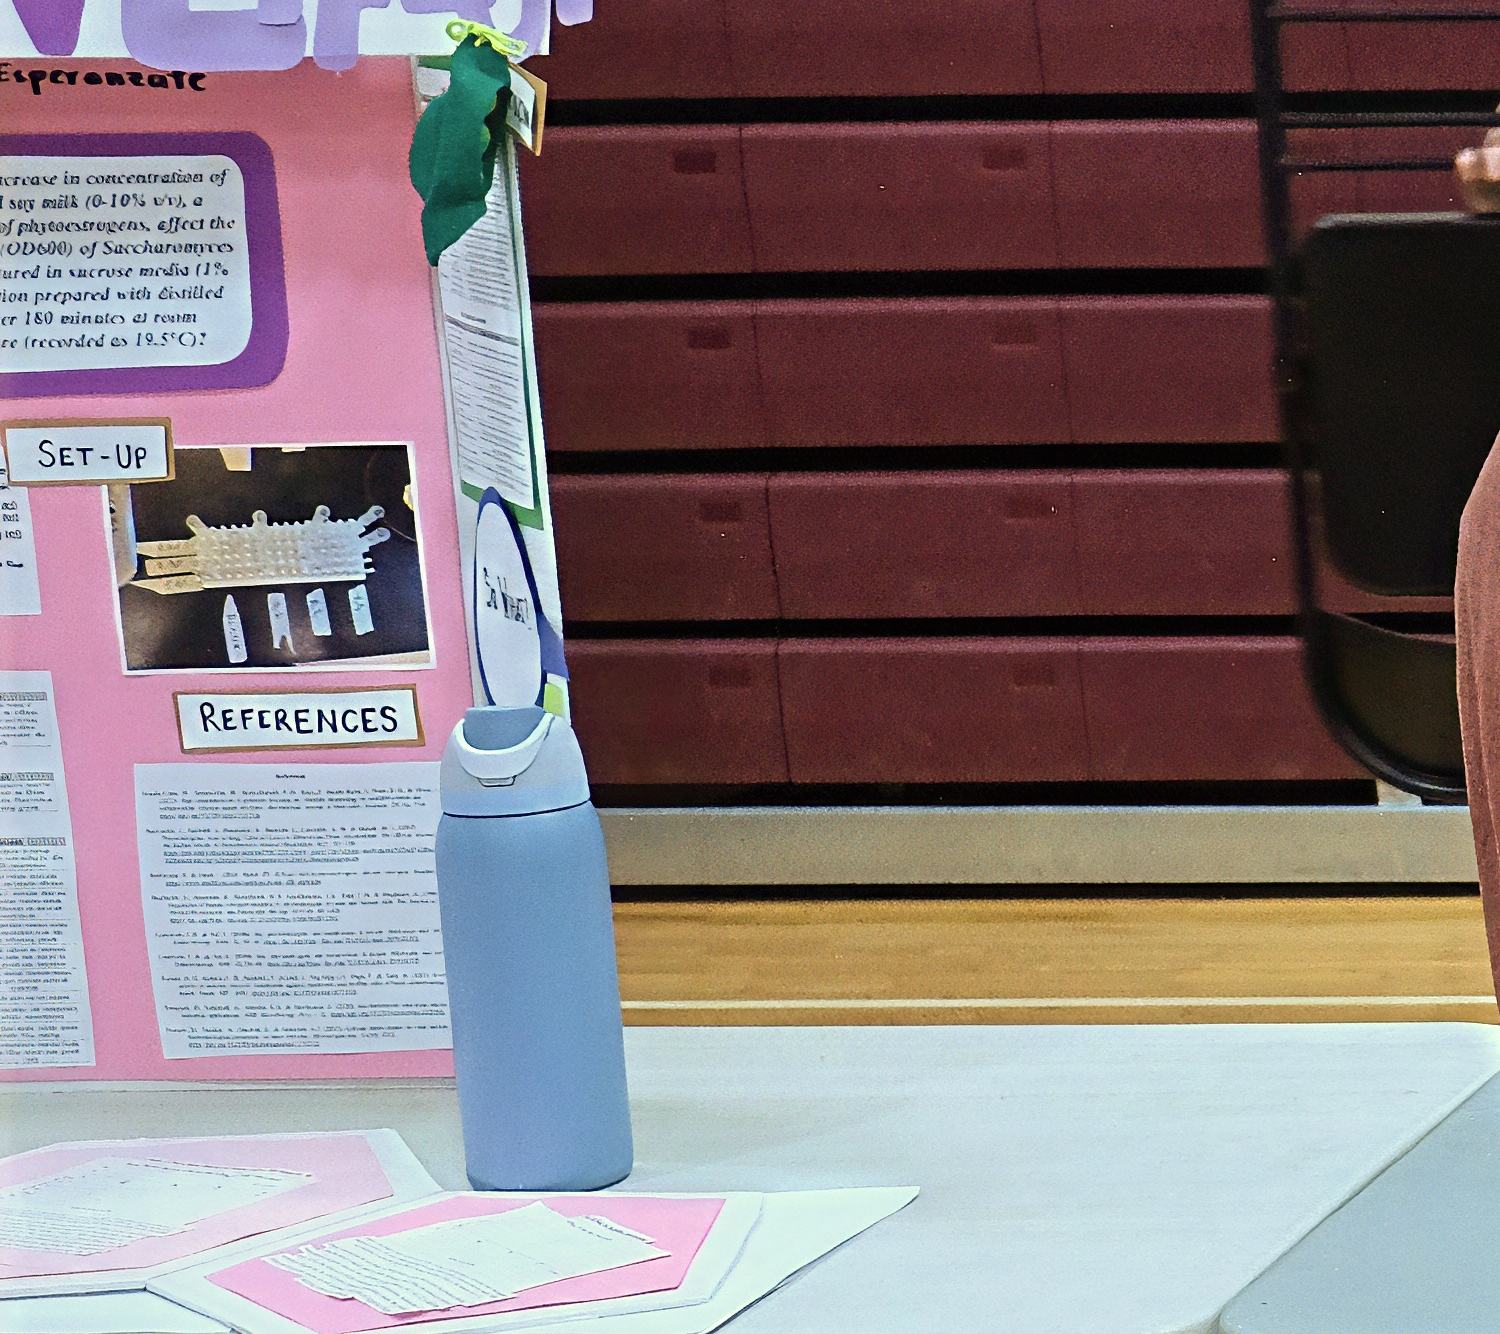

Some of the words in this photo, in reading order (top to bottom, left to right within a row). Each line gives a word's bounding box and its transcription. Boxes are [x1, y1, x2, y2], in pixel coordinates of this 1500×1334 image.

[0, 174, 57, 187] ncrease
[38, 439, 148, 469] SET-UP
[199, 701, 398, 734] REFERENCES
